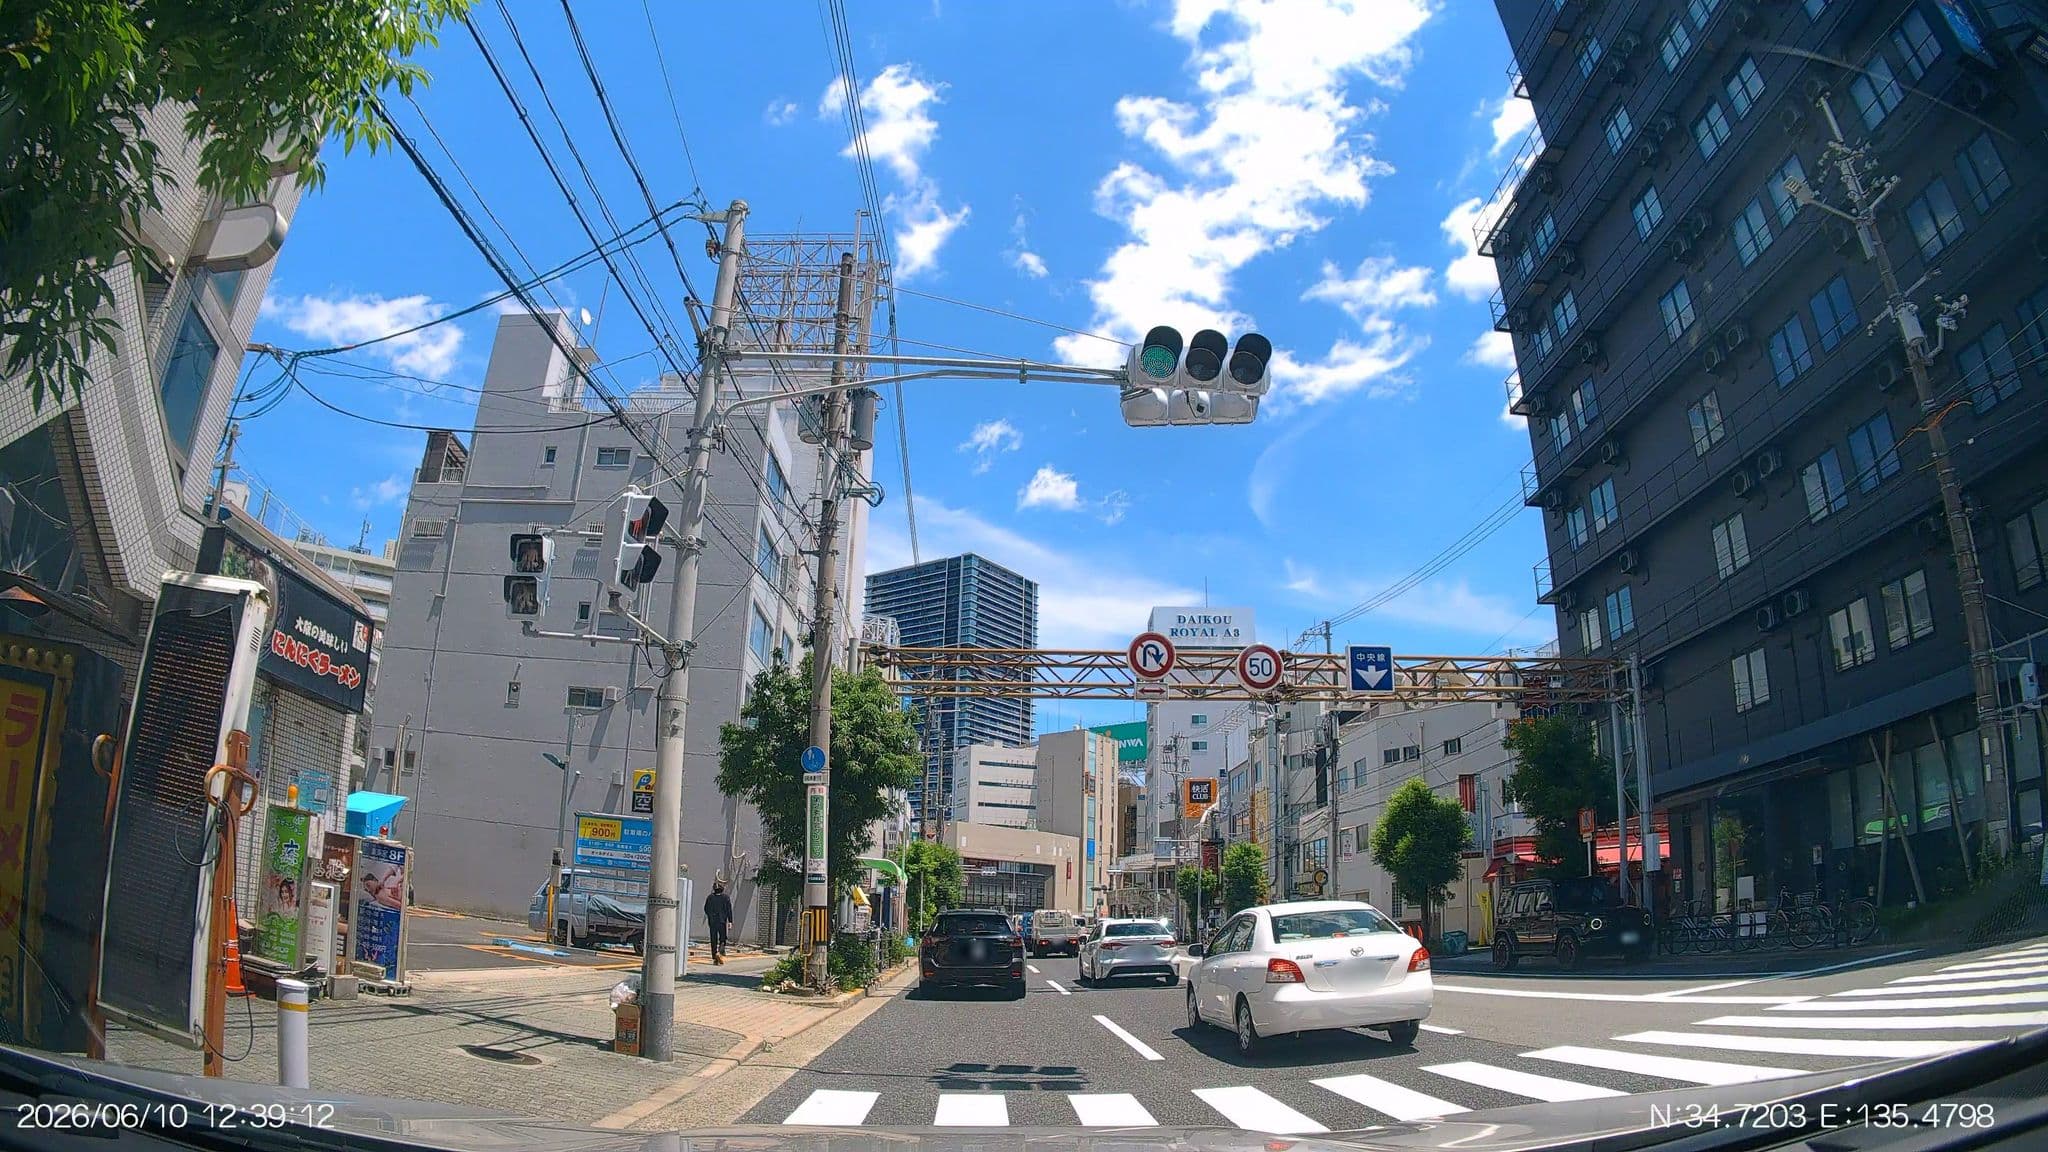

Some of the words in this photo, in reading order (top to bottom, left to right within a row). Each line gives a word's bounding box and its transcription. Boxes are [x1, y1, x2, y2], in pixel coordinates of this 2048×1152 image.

[1177, 615, 1232, 624] DAIKOU
[1171, 628, 1218, 637] ROYAL
[1223, 628, 1240, 637] A3
[271, 629, 361, 689] にんにくラーメン
[1356, 653, 1386, 662] 中央線
[1248, 657, 1274, 678] 50
[1191, 783, 1210, 792] 快活
[634, 793, 651, 812] 空
[388, 850, 404, 860] 8F
